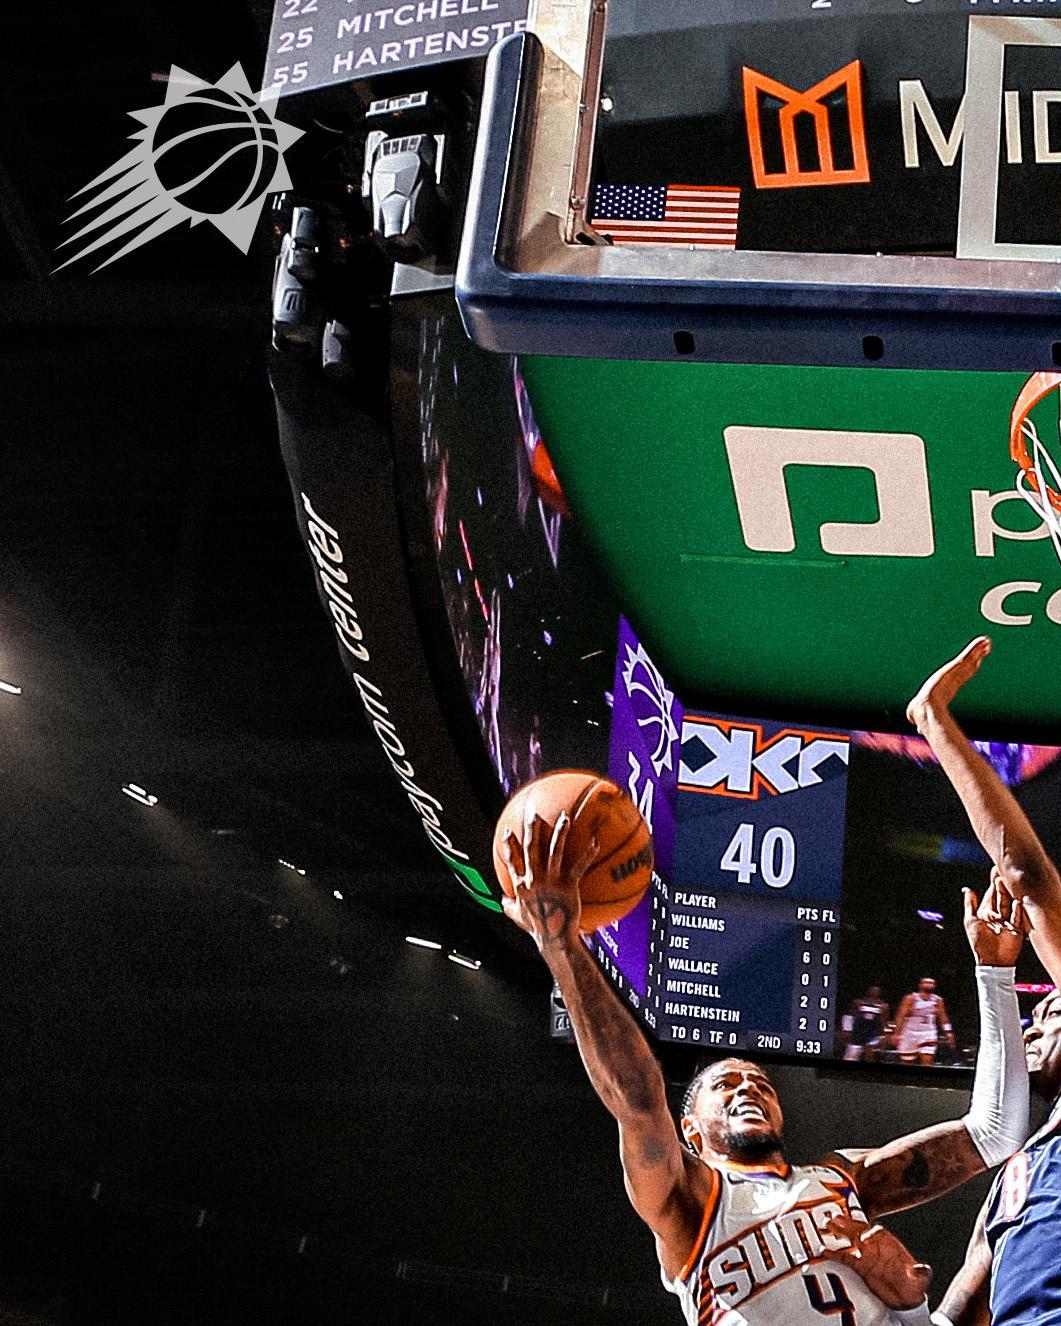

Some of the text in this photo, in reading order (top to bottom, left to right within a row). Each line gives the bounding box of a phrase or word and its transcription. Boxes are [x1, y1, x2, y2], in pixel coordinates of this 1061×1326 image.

[276, 27, 315, 54] 25
[271, 61, 309, 87] 55
[300, 490, 371, 663] center
[353, 672, 470, 861] paycom
[720, 822, 797, 890] 40
[674, 891, 836, 923] PLAYER PTS FL
[671, 913, 832, 943] WILLIAMS 8 0
[669, 935, 831, 966] JOE 6 0
[668, 957, 829, 987] WALLACE 0 1
[666, 979, 829, 1010] MITCHELL 2 0
[665, 1002, 827, 1032] HARTENSTEIN 2 0
[671, 1026, 686, 1039] TO
[692, 1028, 701, 1041] 6
[709, 1030, 724, 1043] TF
[757, 1034, 781, 1049] 2ND
[796, 1040, 821, 1054] 9:33
